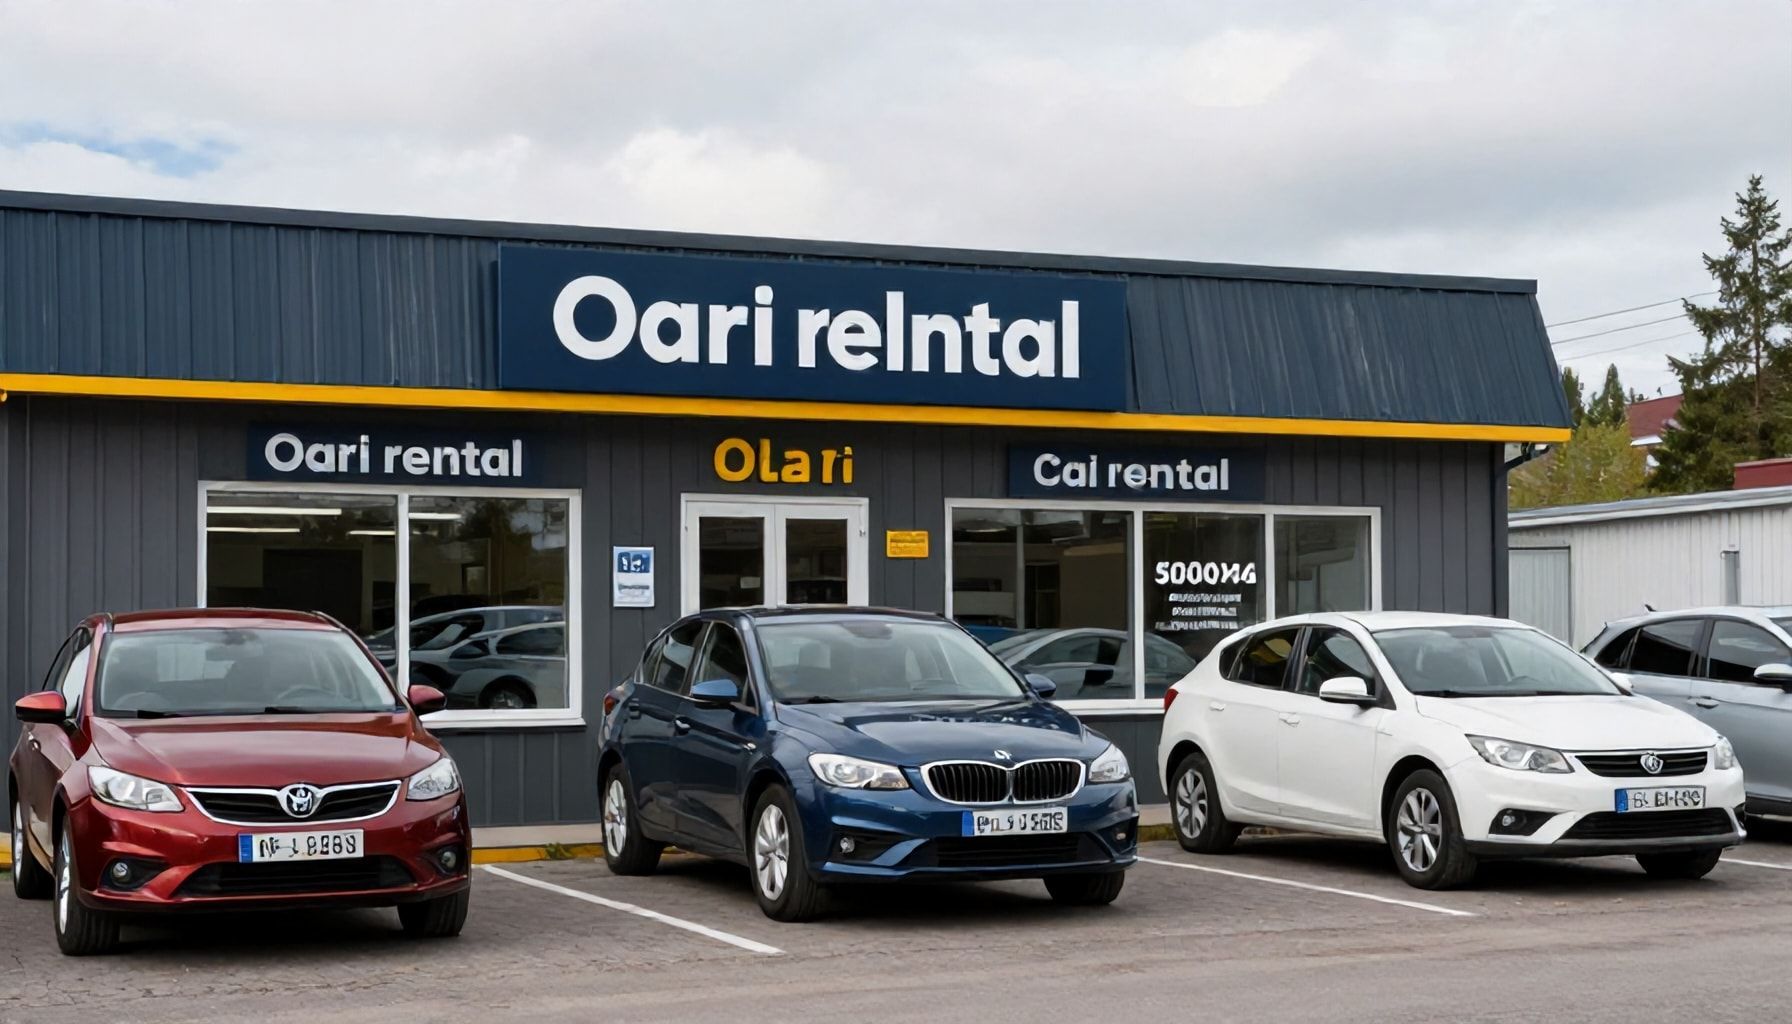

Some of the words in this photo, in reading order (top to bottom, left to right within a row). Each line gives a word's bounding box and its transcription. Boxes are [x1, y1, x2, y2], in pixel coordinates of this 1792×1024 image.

[553, 275, 774, 367] Oari
[264, 432, 370, 474] Oari
[384, 439, 523, 477] rental
[1108, 458, 1229, 491] rental
